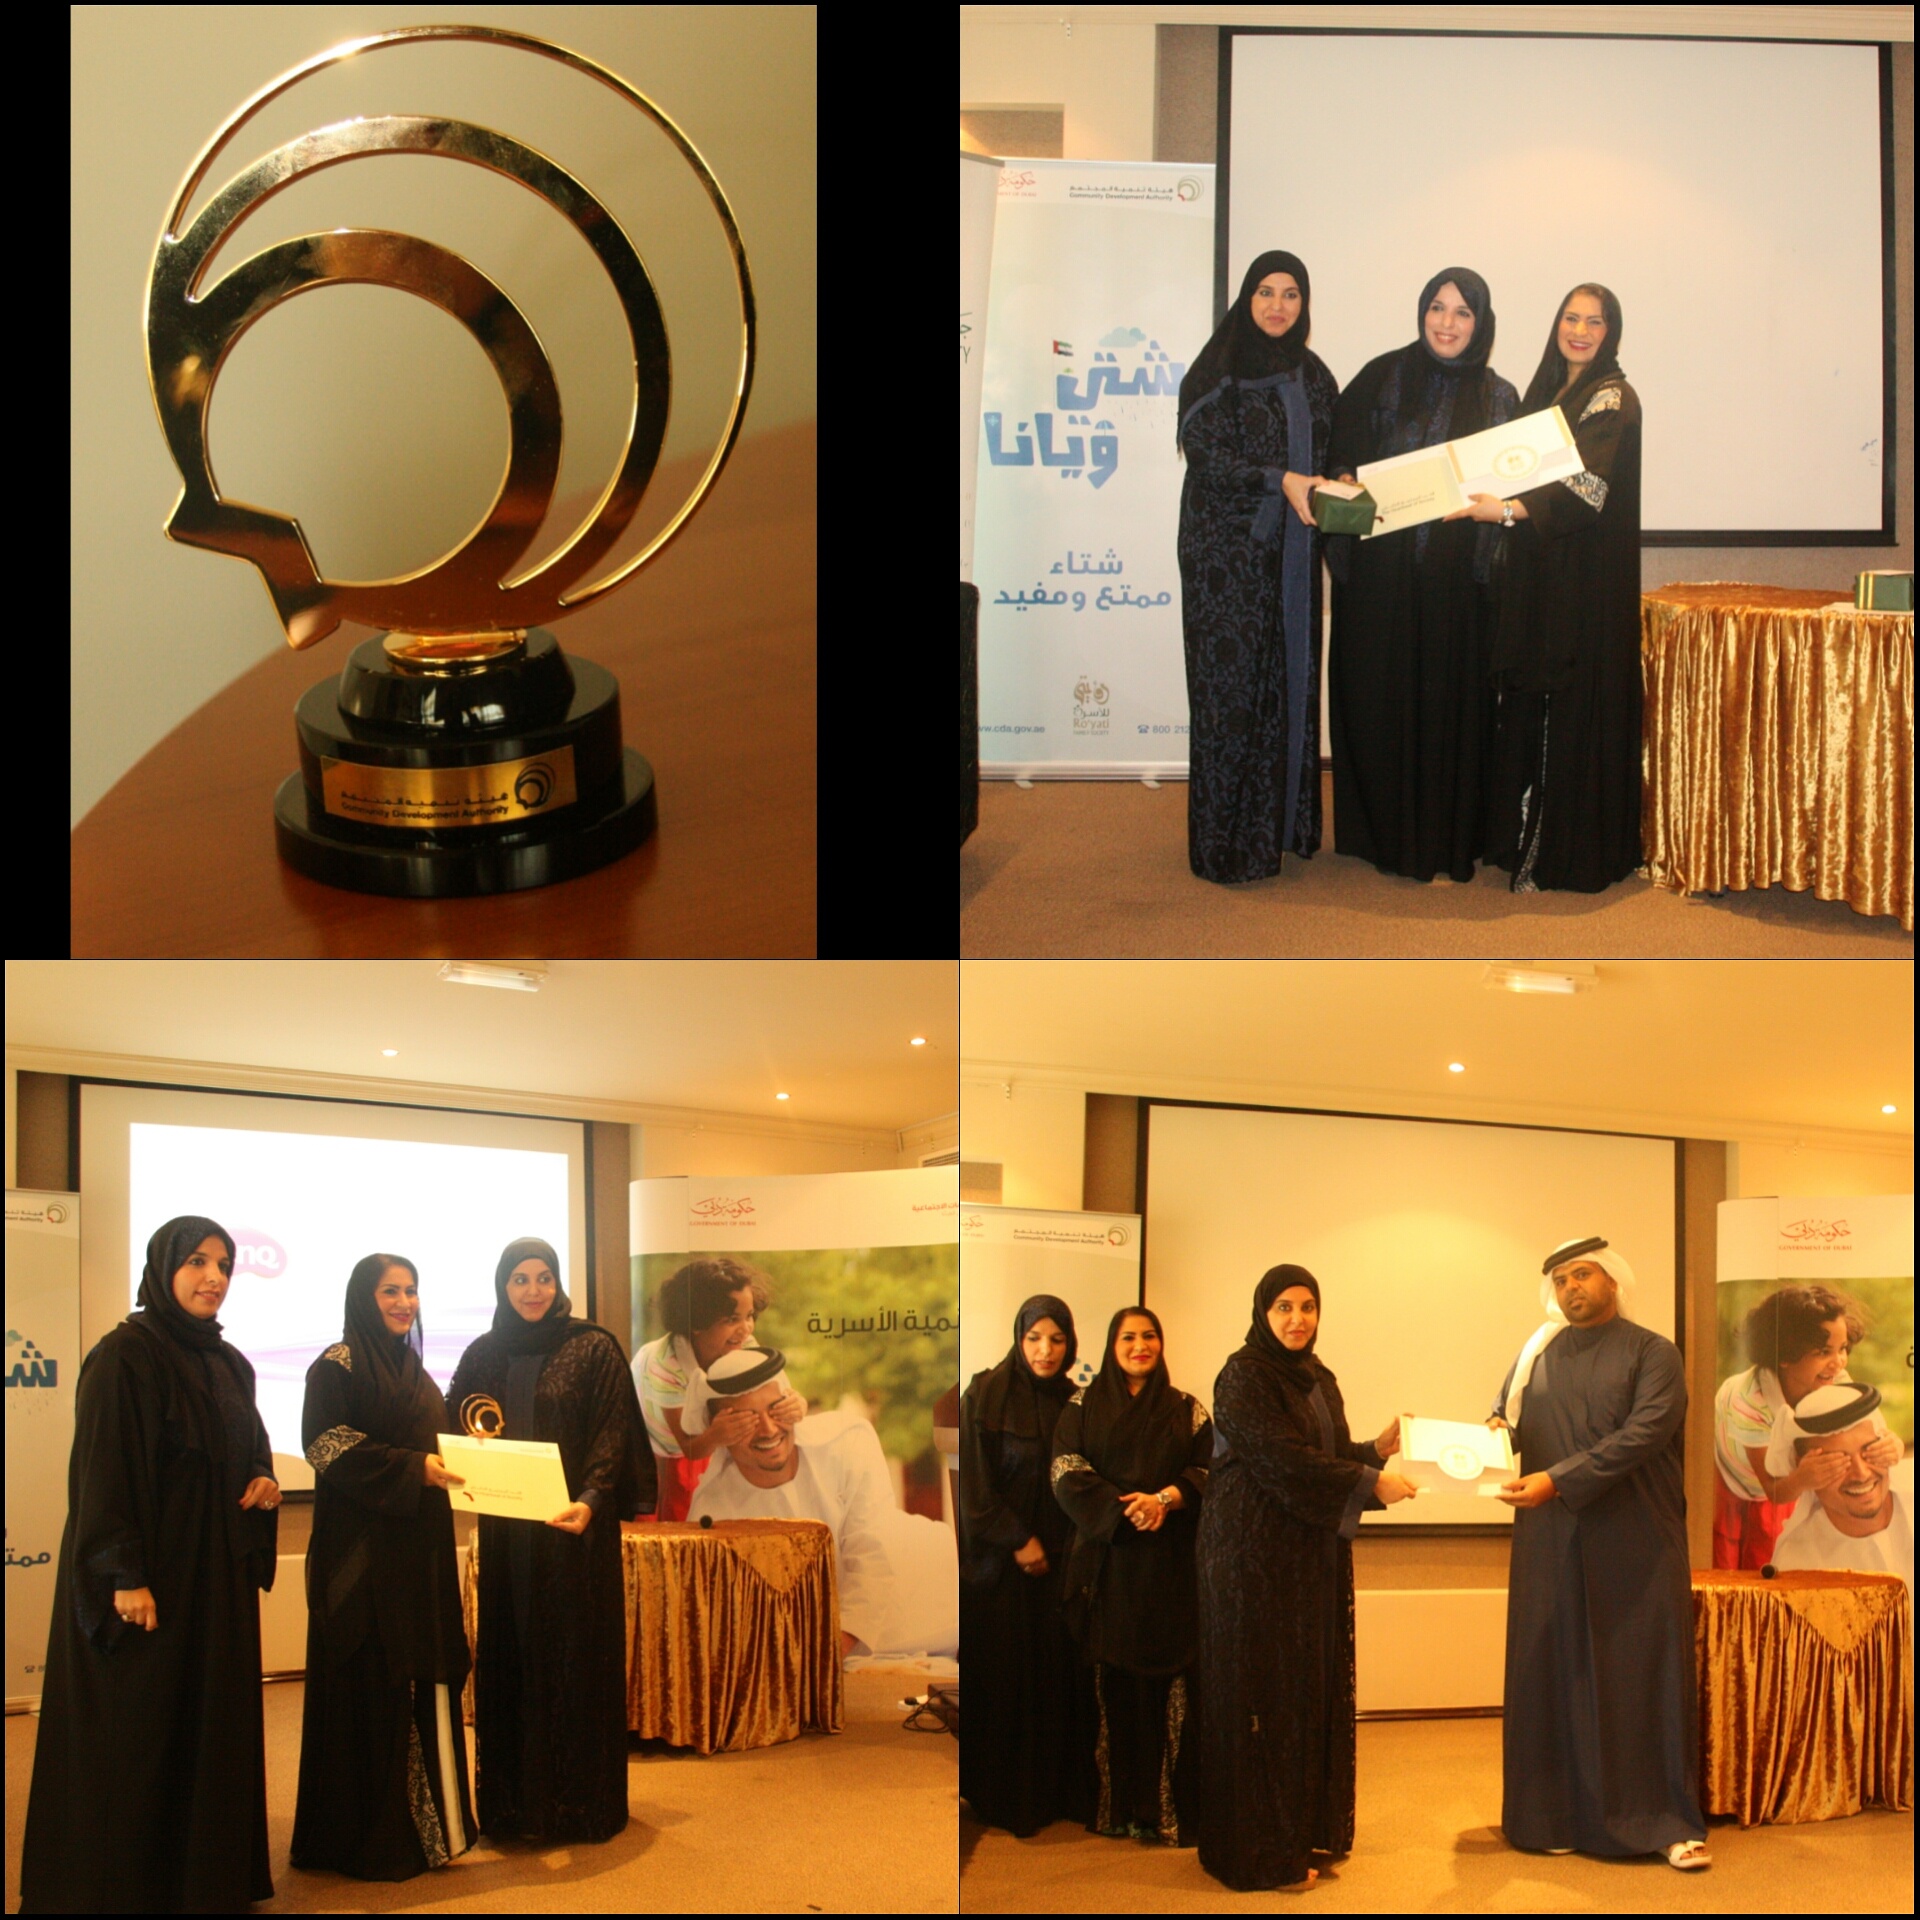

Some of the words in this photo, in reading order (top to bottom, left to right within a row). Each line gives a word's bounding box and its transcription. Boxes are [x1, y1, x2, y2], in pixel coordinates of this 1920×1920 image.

[1069, 191, 1104, 200] Community
[1105, 192, 1145, 201] Development
[1146, 194, 1173, 202] Authority
[983, 412, 1118, 490] ويانا
[1049, 548, 1123, 575] شتاء
[993, 582, 1087, 612] ومفيد
[1095, 584, 1172, 611] ممتع
[1152, 725, 1171, 734] 800
[1174, 725, 1190, 734] 212
[341, 801, 390, 819] Community
[392, 809, 460, 821] Development
[462, 805, 509, 818] Authority
[1013, 1234, 1044, 1242] Community
[1081, 1238, 1105, 1246] Authority
[236, 1245, 280, 1270] nQ
[807, 1305, 898, 1339] الأسرية
